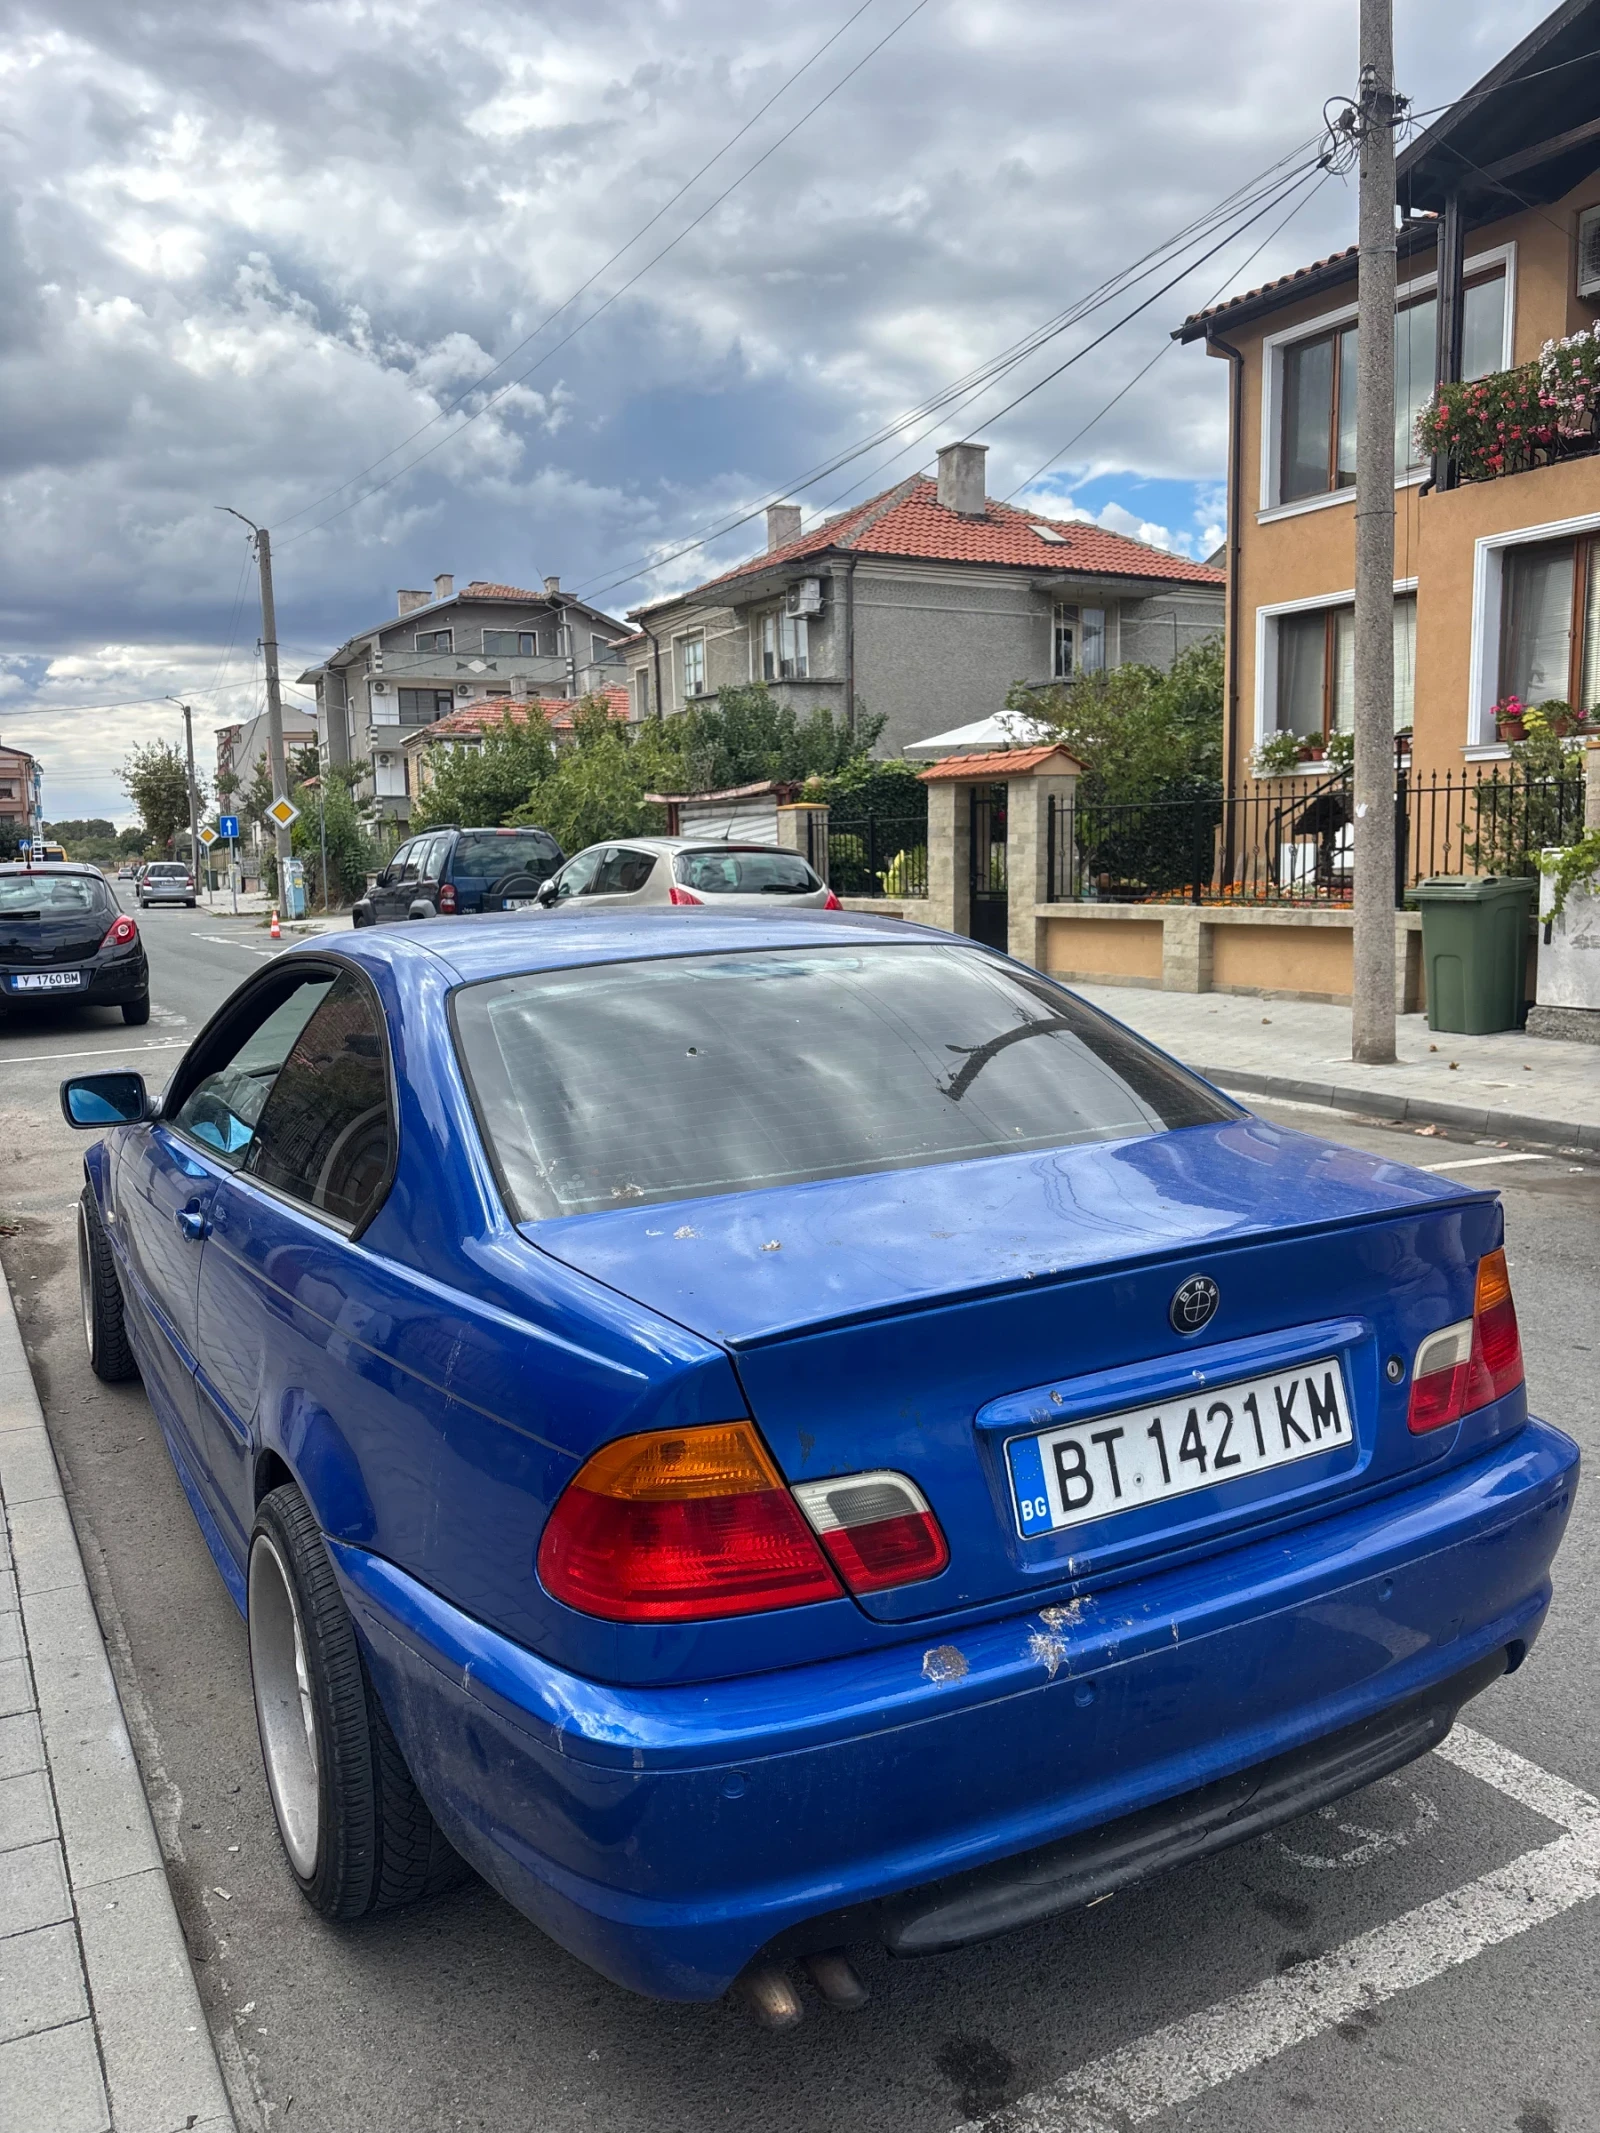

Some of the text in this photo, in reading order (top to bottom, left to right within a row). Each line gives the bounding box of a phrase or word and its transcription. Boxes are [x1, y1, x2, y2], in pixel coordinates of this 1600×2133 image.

[37, 974, 62, 985] 1760
[1179, 1281, 1217, 1303] BMW
[1052, 1372, 1342, 1512] BT 1421 KM
[1021, 1497, 1047, 1521] BG
